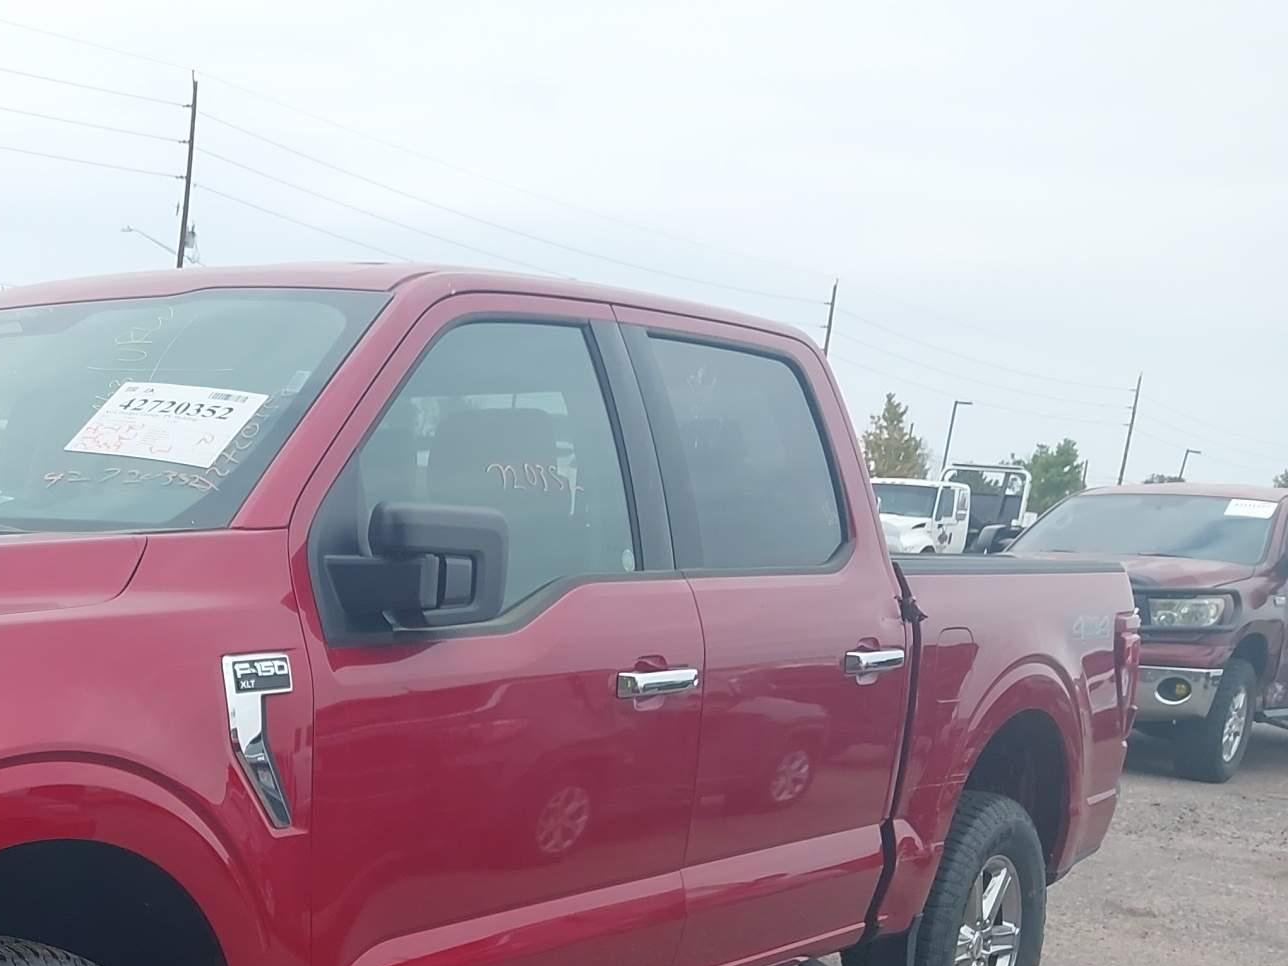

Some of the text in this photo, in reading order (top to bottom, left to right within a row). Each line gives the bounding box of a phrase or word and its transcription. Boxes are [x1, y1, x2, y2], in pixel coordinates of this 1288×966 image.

[119, 398, 234, 420] 42720352
[234, 660, 289, 678] F-150
[240, 680, 255, 689] XLT
